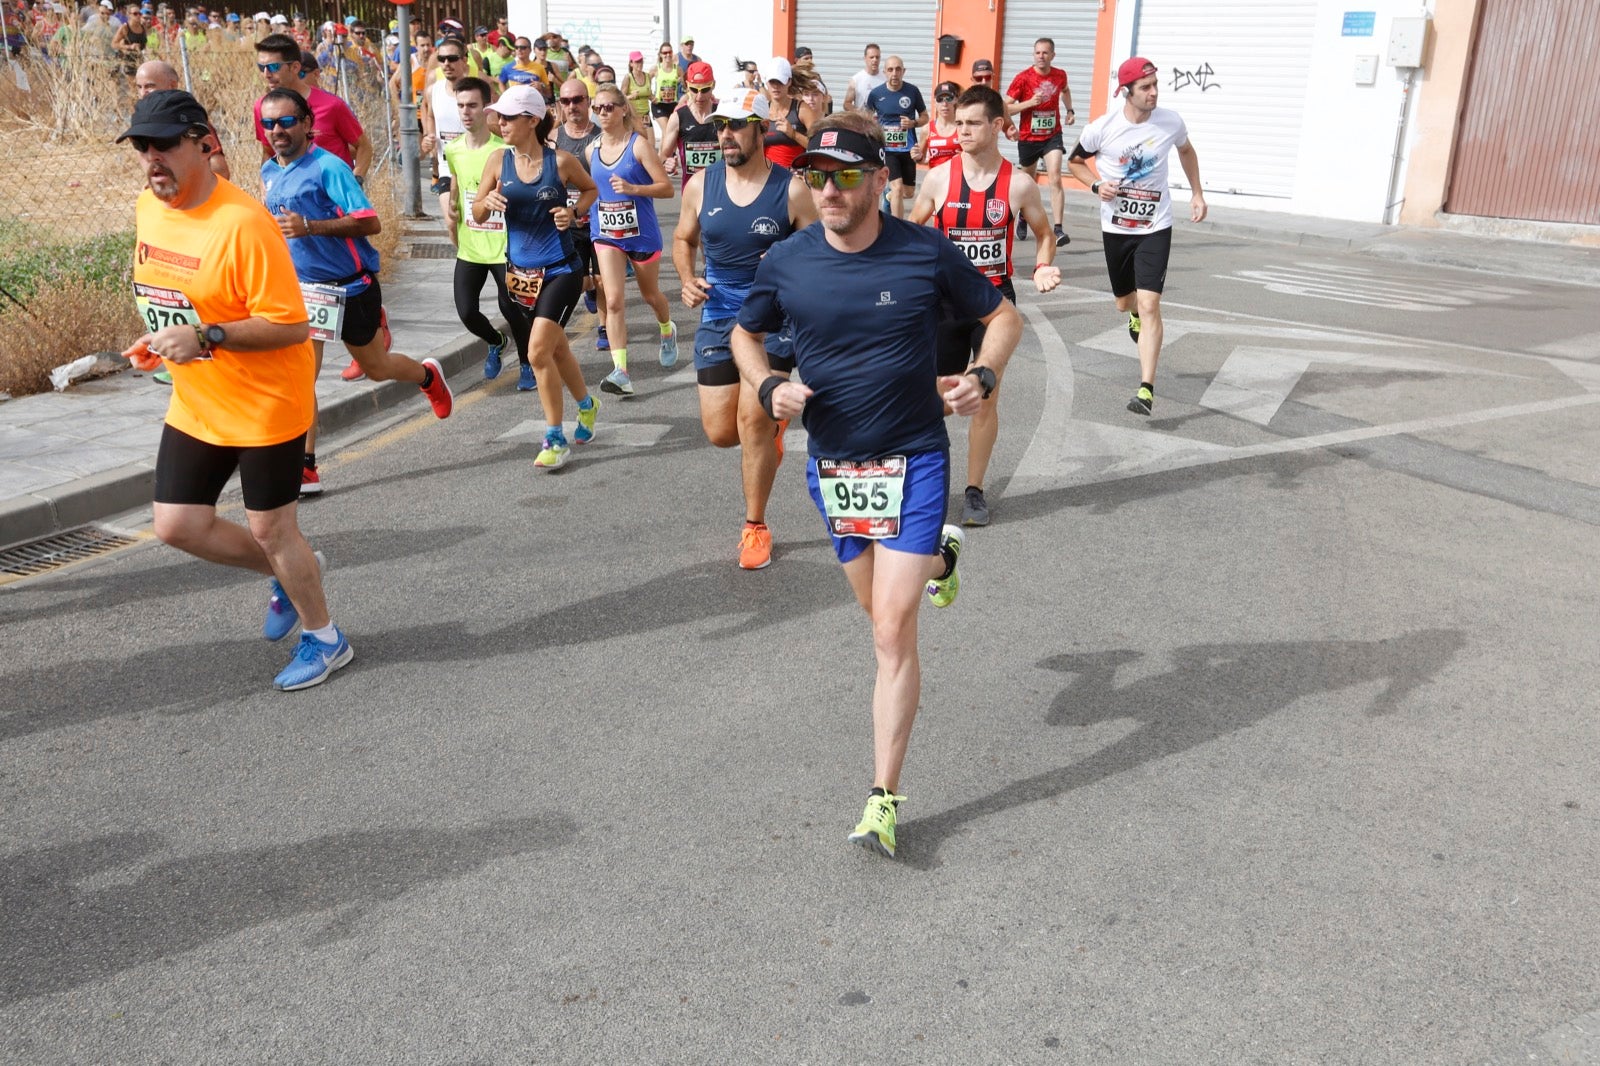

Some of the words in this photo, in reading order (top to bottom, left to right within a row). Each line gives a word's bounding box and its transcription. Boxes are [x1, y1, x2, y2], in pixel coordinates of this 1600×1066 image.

[1036, 119, 1053, 127] 156
[886, 132, 904, 141] 266
[692, 153, 716, 164] 875
[1120, 200, 1156, 216] 3032
[602, 212, 634, 226] 3036
[834, 481, 889, 511] 955
